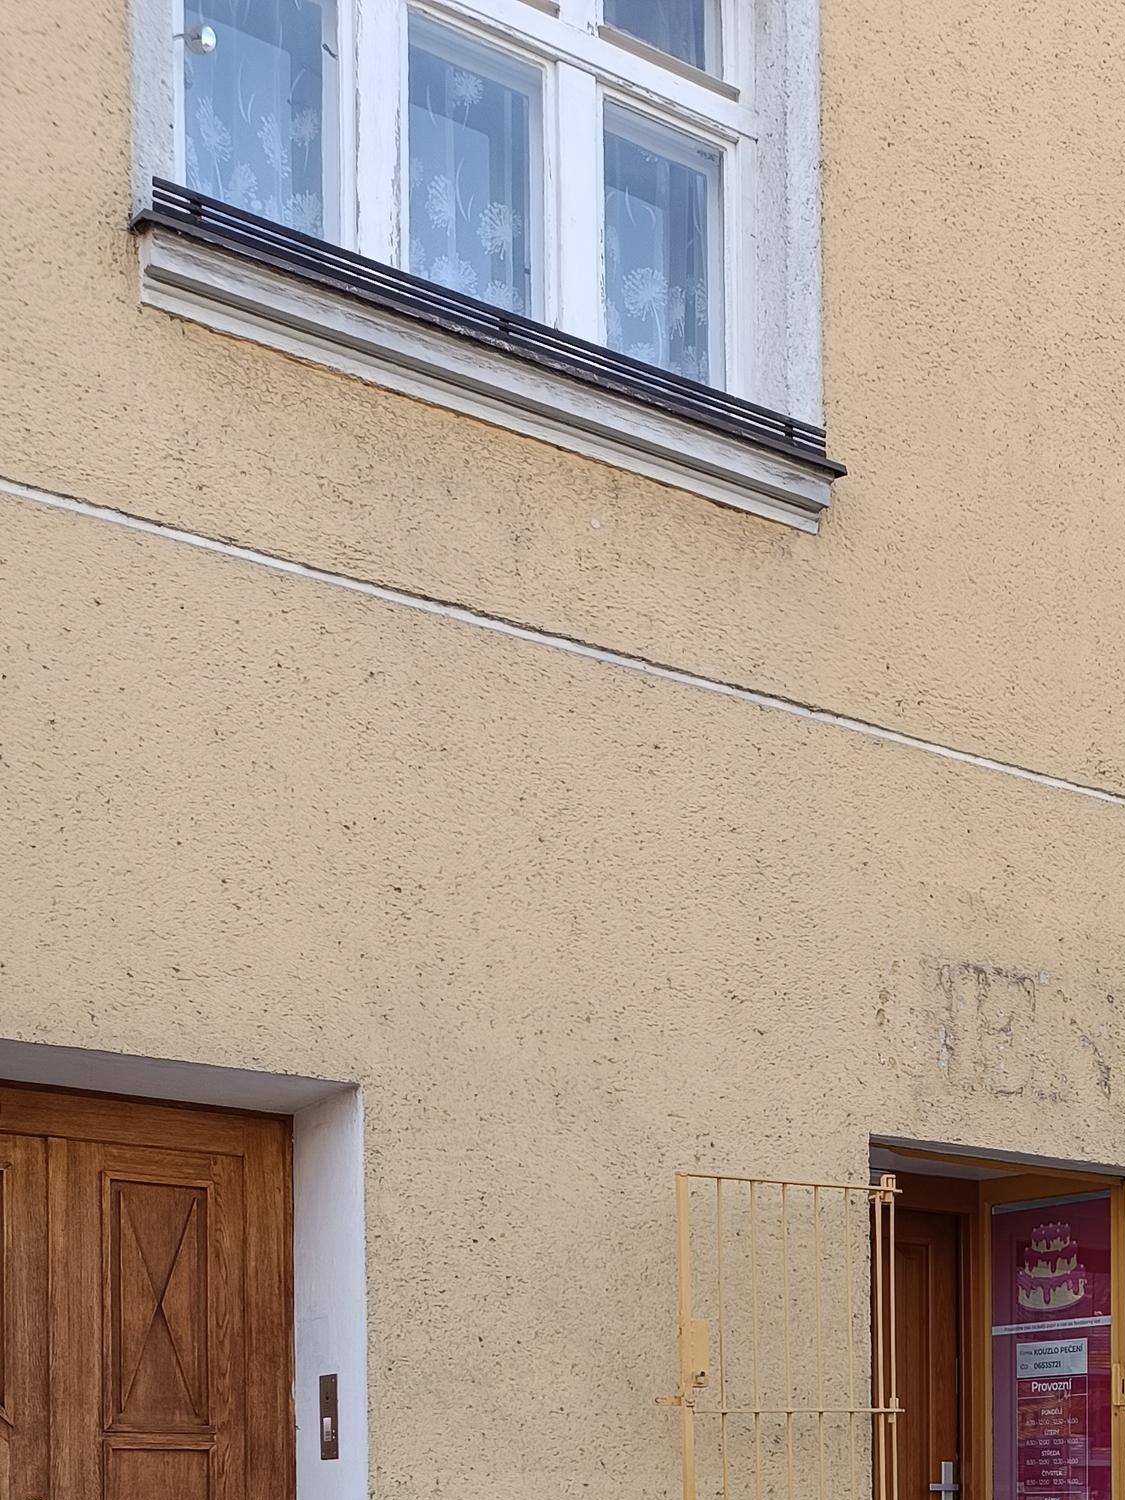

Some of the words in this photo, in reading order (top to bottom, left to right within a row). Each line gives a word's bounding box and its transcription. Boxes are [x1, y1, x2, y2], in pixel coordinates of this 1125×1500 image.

[1033, 1347, 1059, 1356] KOUZLO
[1060, 1344, 1083, 1354] PEČENÍ
[1031, 1378, 1072, 1392] Provozní
